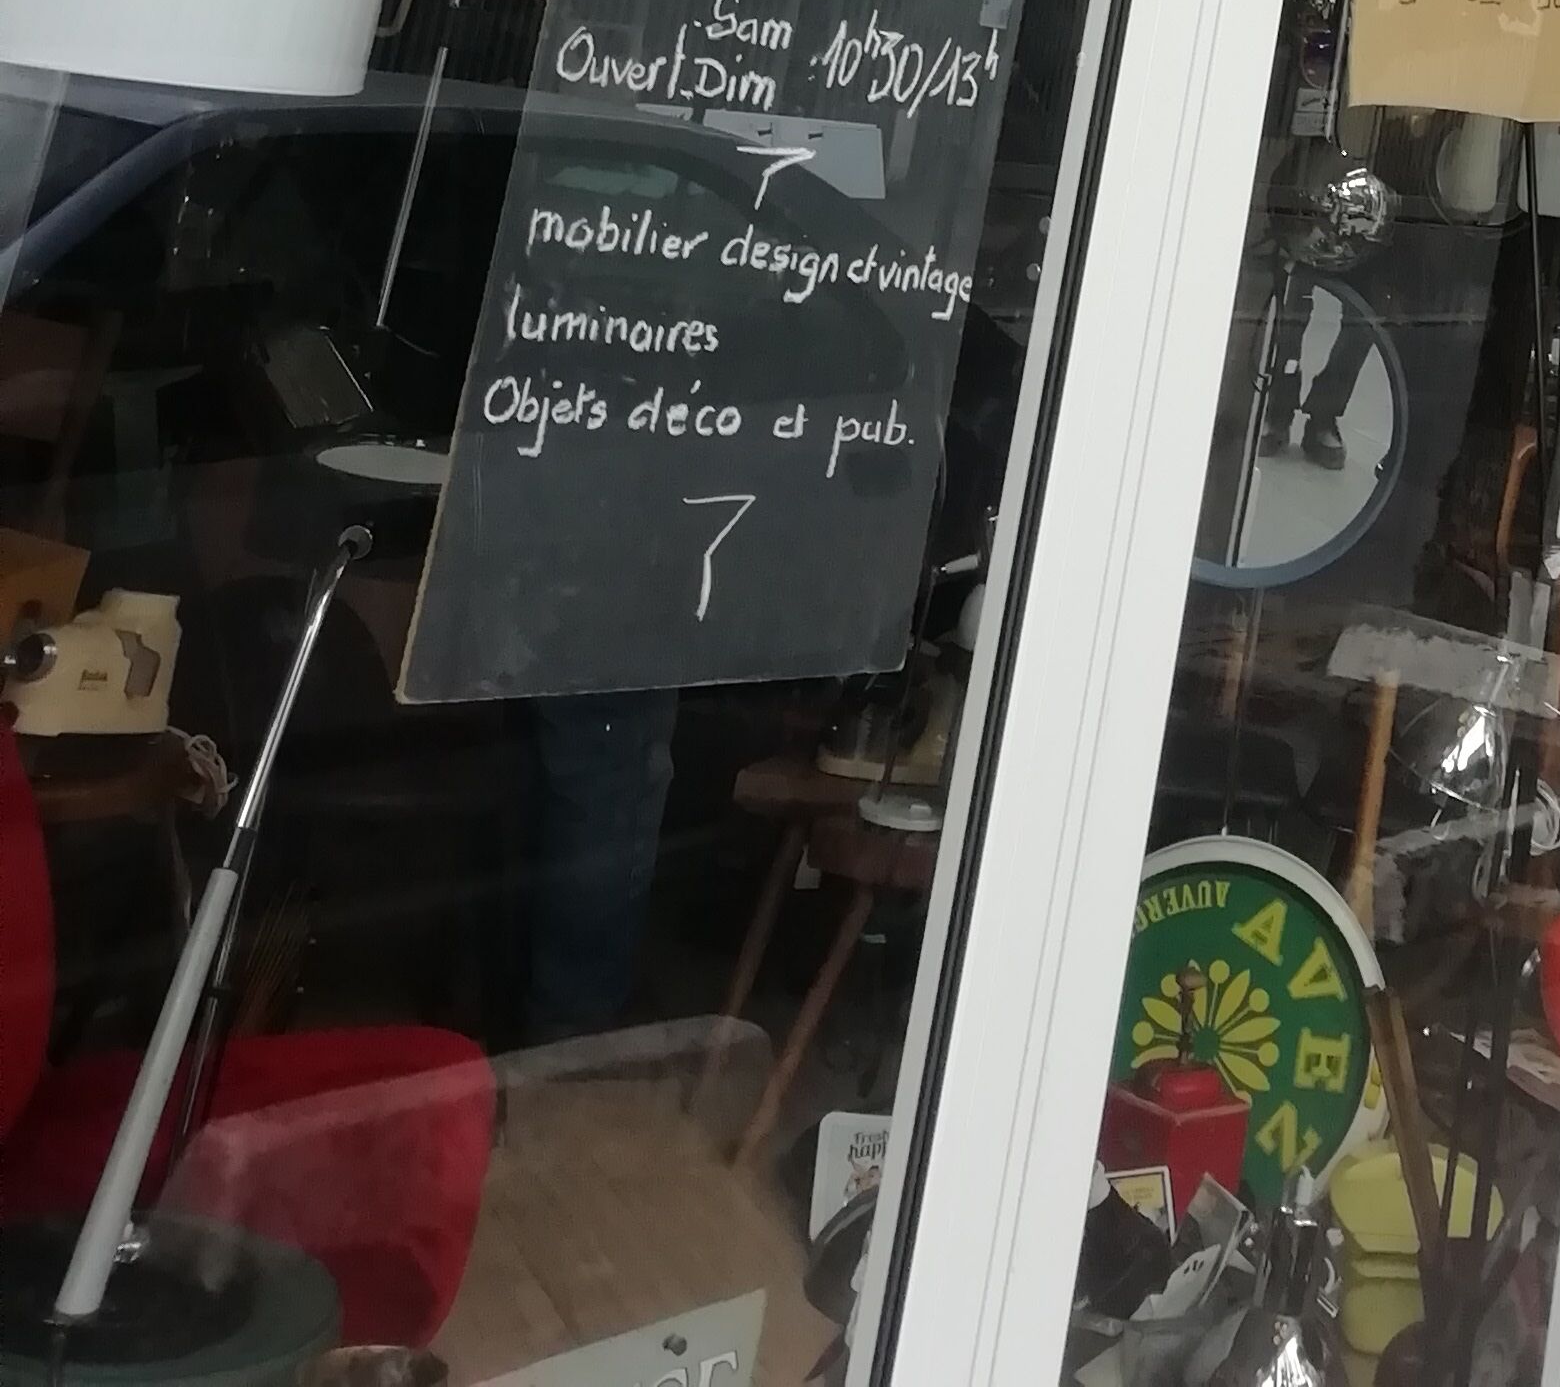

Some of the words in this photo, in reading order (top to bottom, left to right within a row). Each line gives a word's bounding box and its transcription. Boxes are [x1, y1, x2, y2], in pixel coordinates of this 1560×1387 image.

[526, 207, 710, 261] mobilier
[720, 225, 840, 303] design
[877, 246, 974, 321] vintage
[503, 284, 720, 354] luminaires
[482, 377, 607, 458] Objets
[626, 380, 742, 437] déco
[772, 404, 809, 440] et
[825, 399, 917, 479] pub.
[1132, 879, 1231, 937] AUVERG
